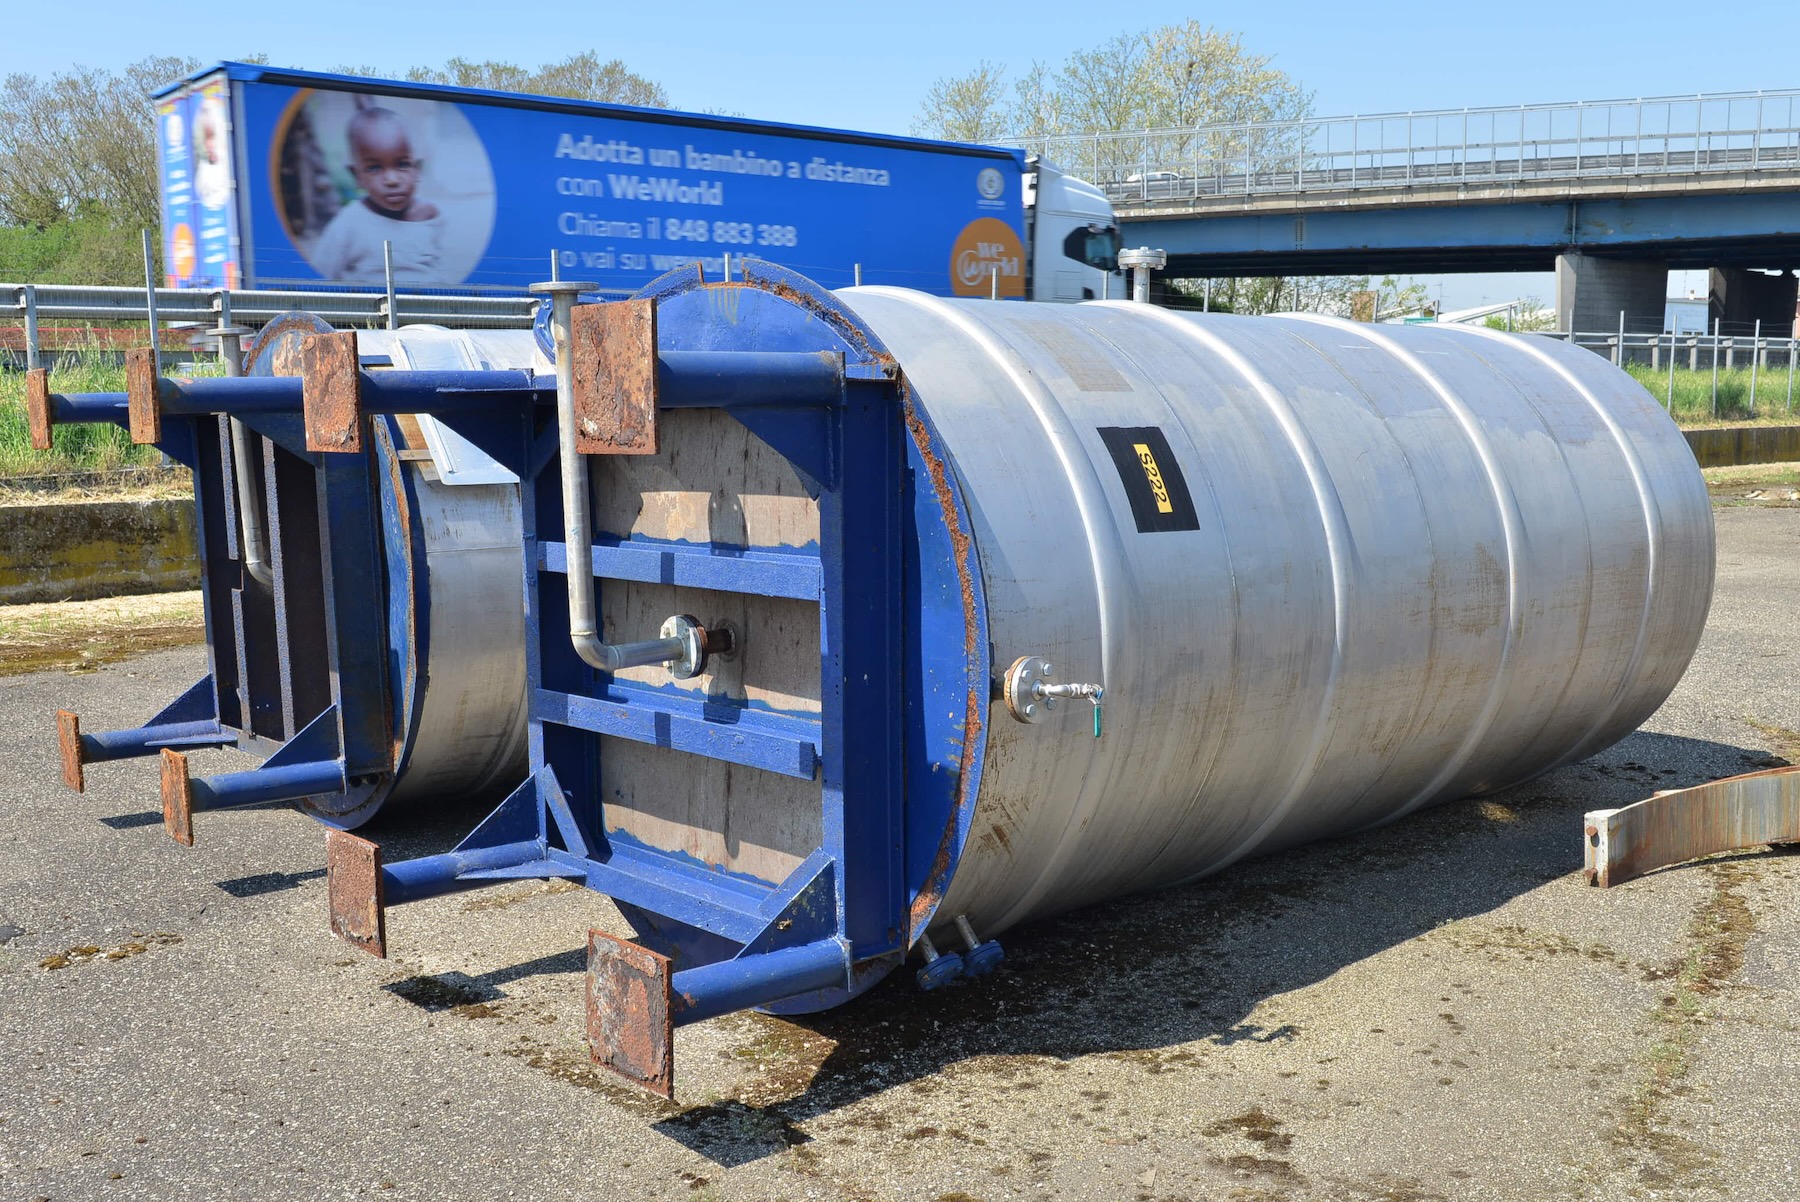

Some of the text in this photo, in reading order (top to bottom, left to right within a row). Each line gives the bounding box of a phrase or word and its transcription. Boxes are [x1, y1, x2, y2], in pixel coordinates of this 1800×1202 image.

[554, 133, 890, 186] Adotta un bambino a distanza
[556, 173, 723, 206] con WeWorld
[557, 211, 798, 248] Chiama il 848 883 388
[581, 246, 616, 269] vai
[620, 253, 647, 270] su
[1139, 453, 1167, 503] S222
